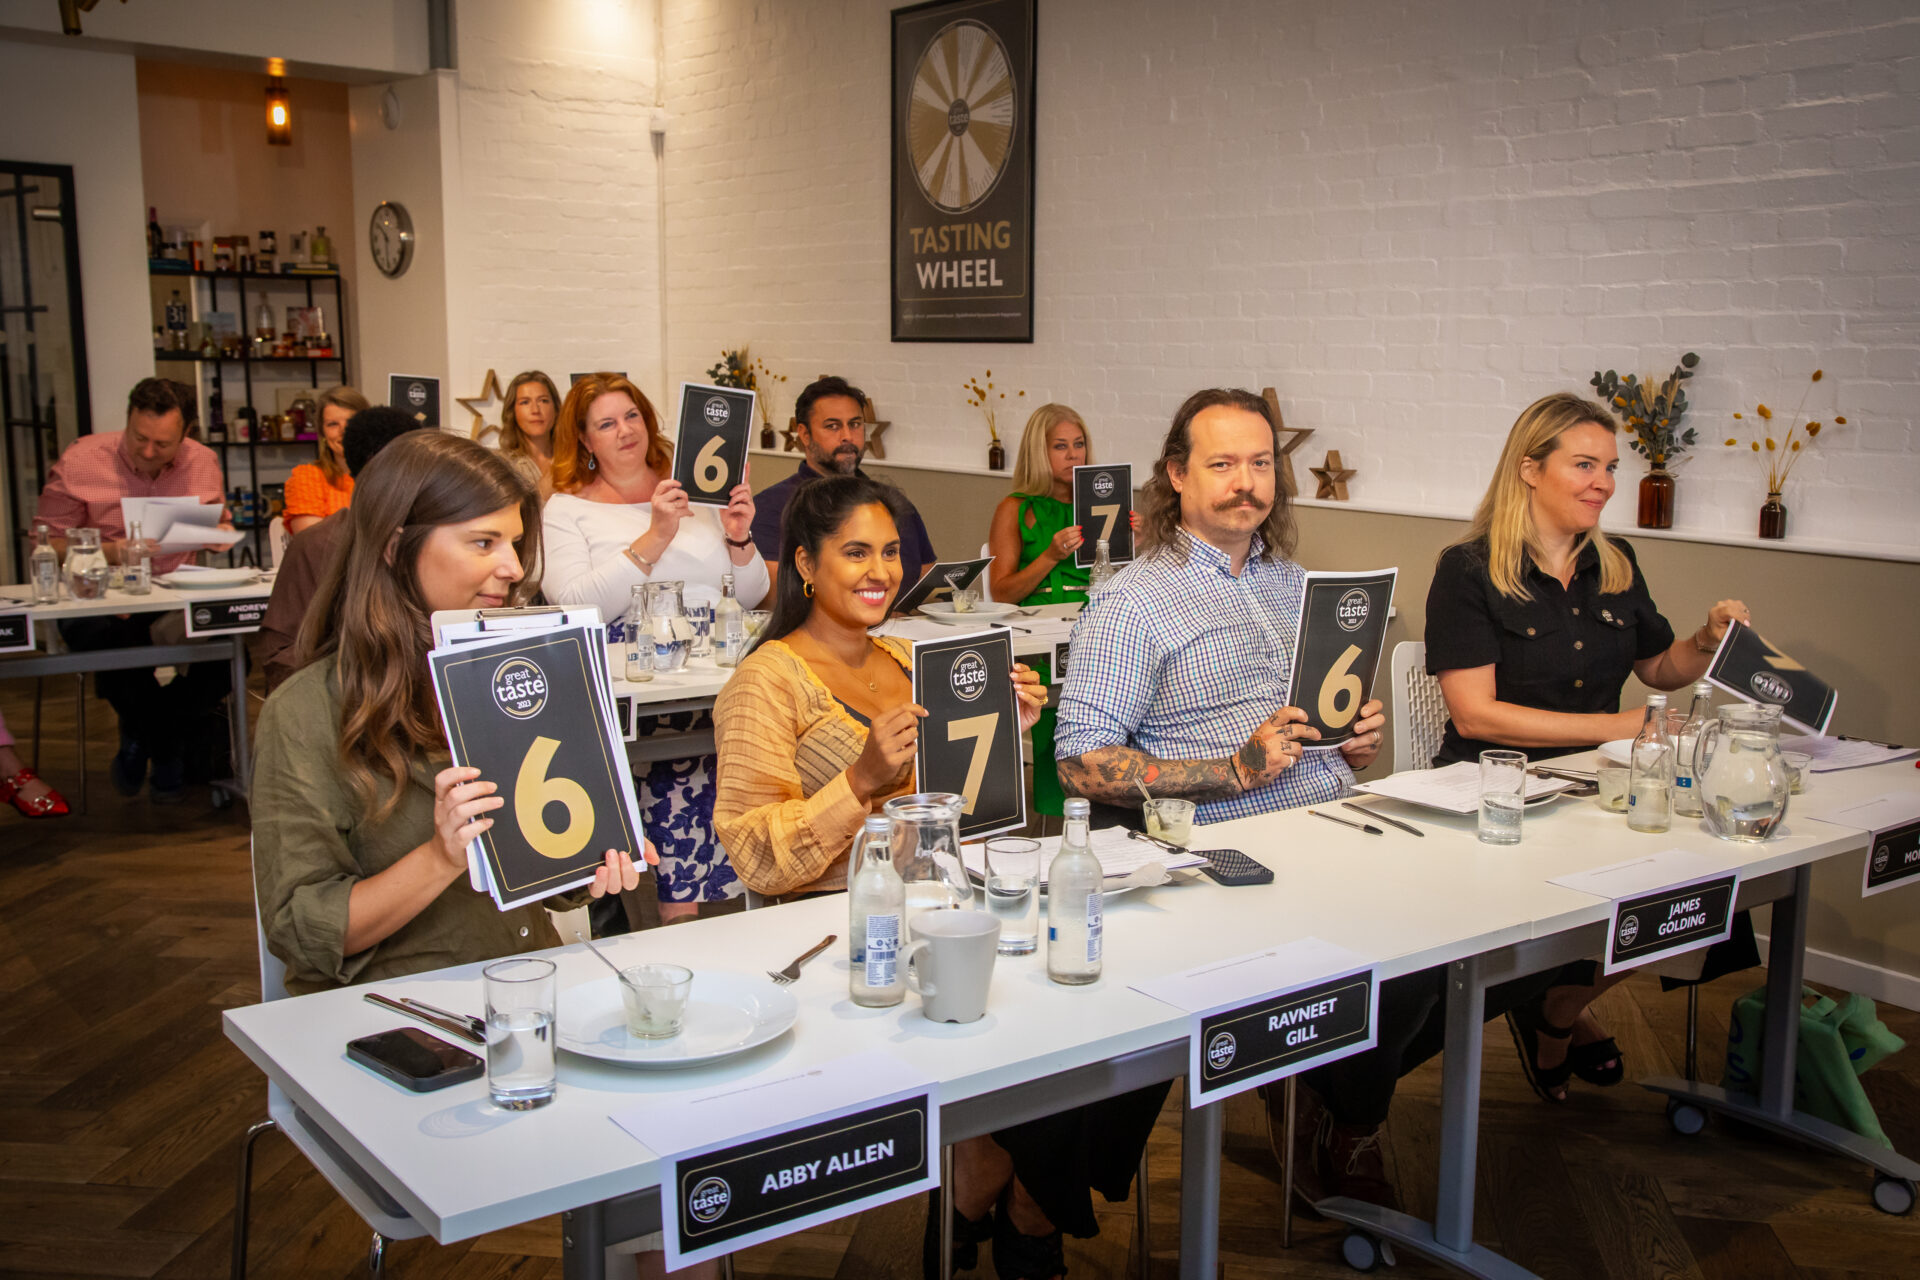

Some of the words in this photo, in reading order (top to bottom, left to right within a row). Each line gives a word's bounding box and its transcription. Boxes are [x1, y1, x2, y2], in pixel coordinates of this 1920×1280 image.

[909, 220, 1011, 254] TASTING
[916, 258, 1003, 289] WHEEL
[706, 407, 729, 418] taste
[693, 435, 729, 493] 6
[1094, 482, 1113, 490] taste
[1091, 503, 1121, 541] 7
[228, 603, 269, 614] ANDREW
[1339, 605, 1368, 618] taste
[1346, 597, 1363, 607] great
[238, 612, 260, 622] BIRD
[505, 668, 531, 686] great
[953, 669, 985, 686] taste
[960, 660, 978, 673] great
[496, 678, 545, 702] taste
[1317, 643, 1363, 729] 6
[516, 699, 532, 709] 2023
[947, 712, 999, 815] 7
[514, 735, 595, 859] 6
[1668, 897, 1701, 920] JAMES
[1658, 912, 1706, 936] GOLDING
[1268, 997, 1338, 1031] RAVNEET
[1285, 1024, 1319, 1046] GILL
[1210, 1045, 1234, 1059] taste
[760, 1160, 822, 1194] ABBY
[825, 1139, 894, 1176] ALLEN
[693, 1192, 728, 1211] taste
